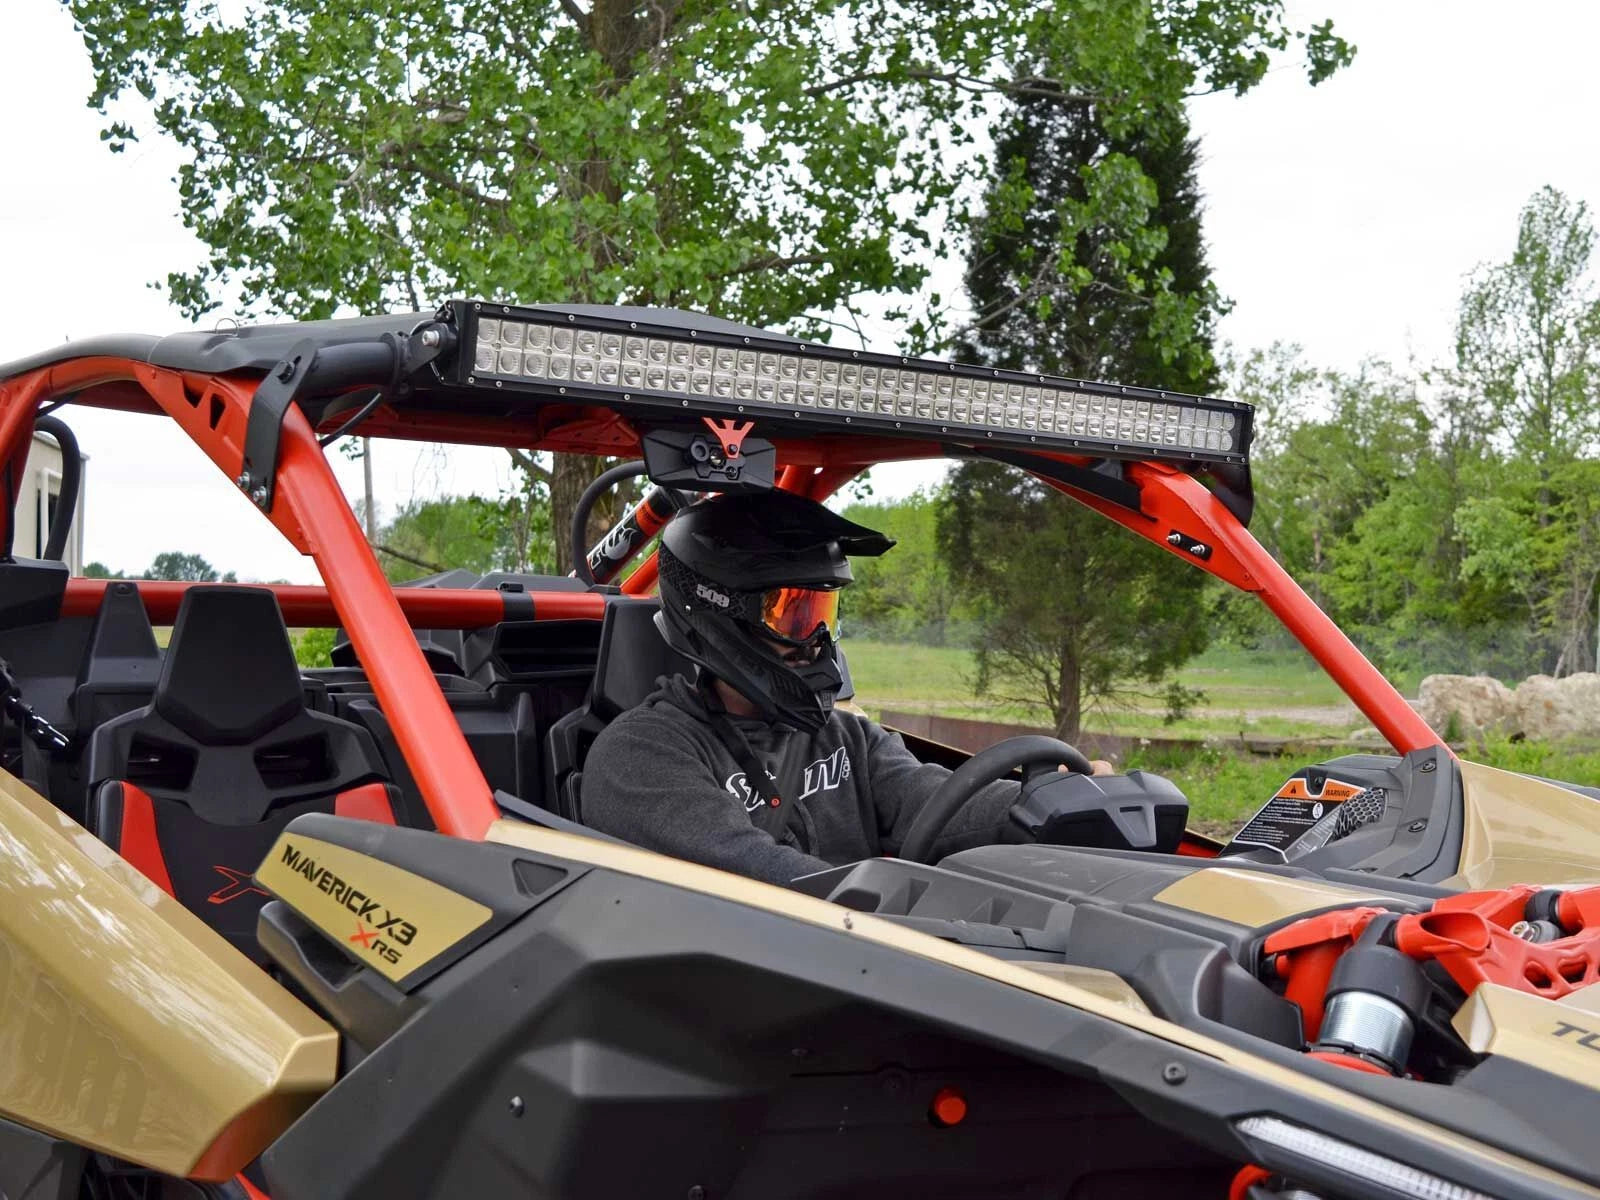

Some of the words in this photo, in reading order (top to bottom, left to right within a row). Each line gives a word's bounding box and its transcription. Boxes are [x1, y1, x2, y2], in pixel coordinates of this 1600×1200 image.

[696, 583, 730, 608] 509
[1325, 789, 1350, 798] WARNING
[281, 844, 380, 924] MAVERICK
[376, 910, 417, 946] X3
